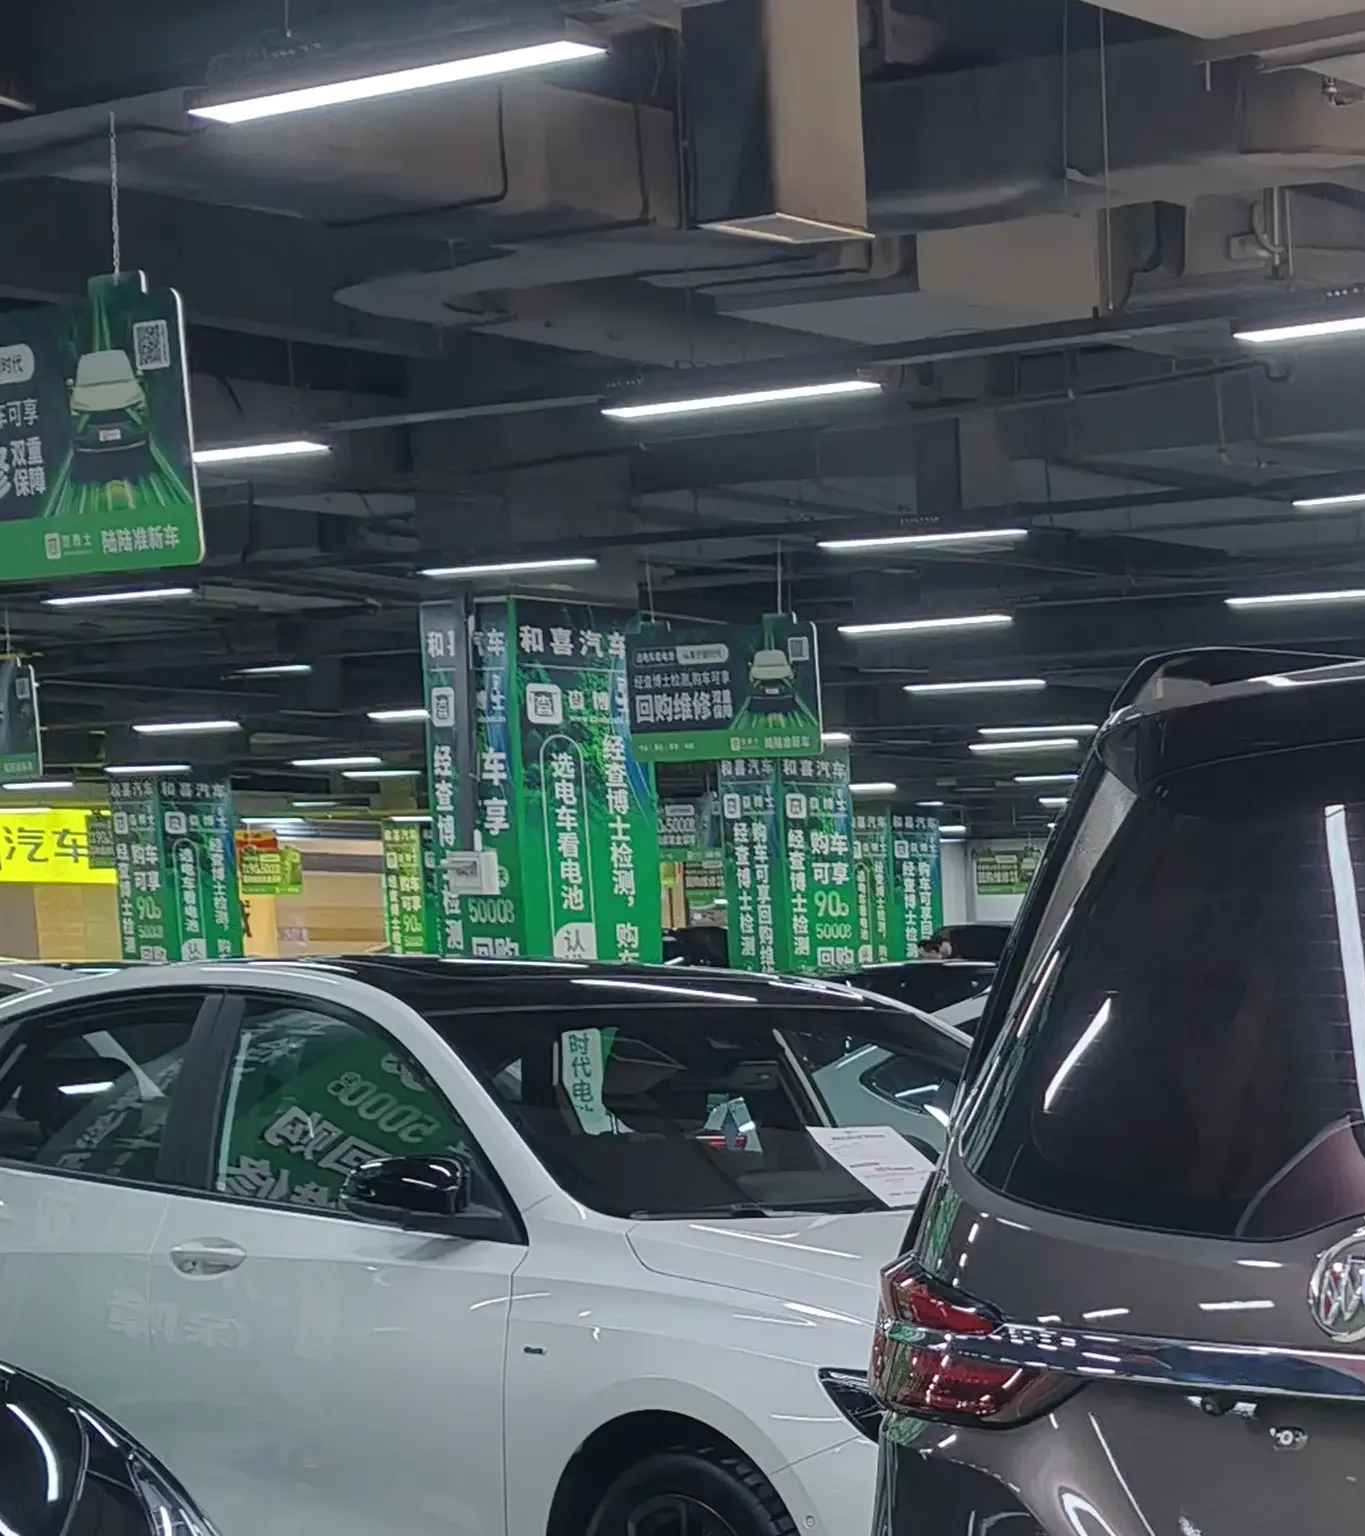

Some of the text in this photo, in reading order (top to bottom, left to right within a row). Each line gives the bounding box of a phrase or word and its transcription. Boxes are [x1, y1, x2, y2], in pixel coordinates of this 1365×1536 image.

[10, 436, 43, 467] 双重
[14, 466, 46, 497] 保障
[519, 624, 627, 661] 和喜汽车
[635, 690, 712, 723] 回购维修
[2, 825, 89, 864] 汽车
[552, 752, 585, 911] 选电车看电池
[812, 861, 850, 887] 可享
